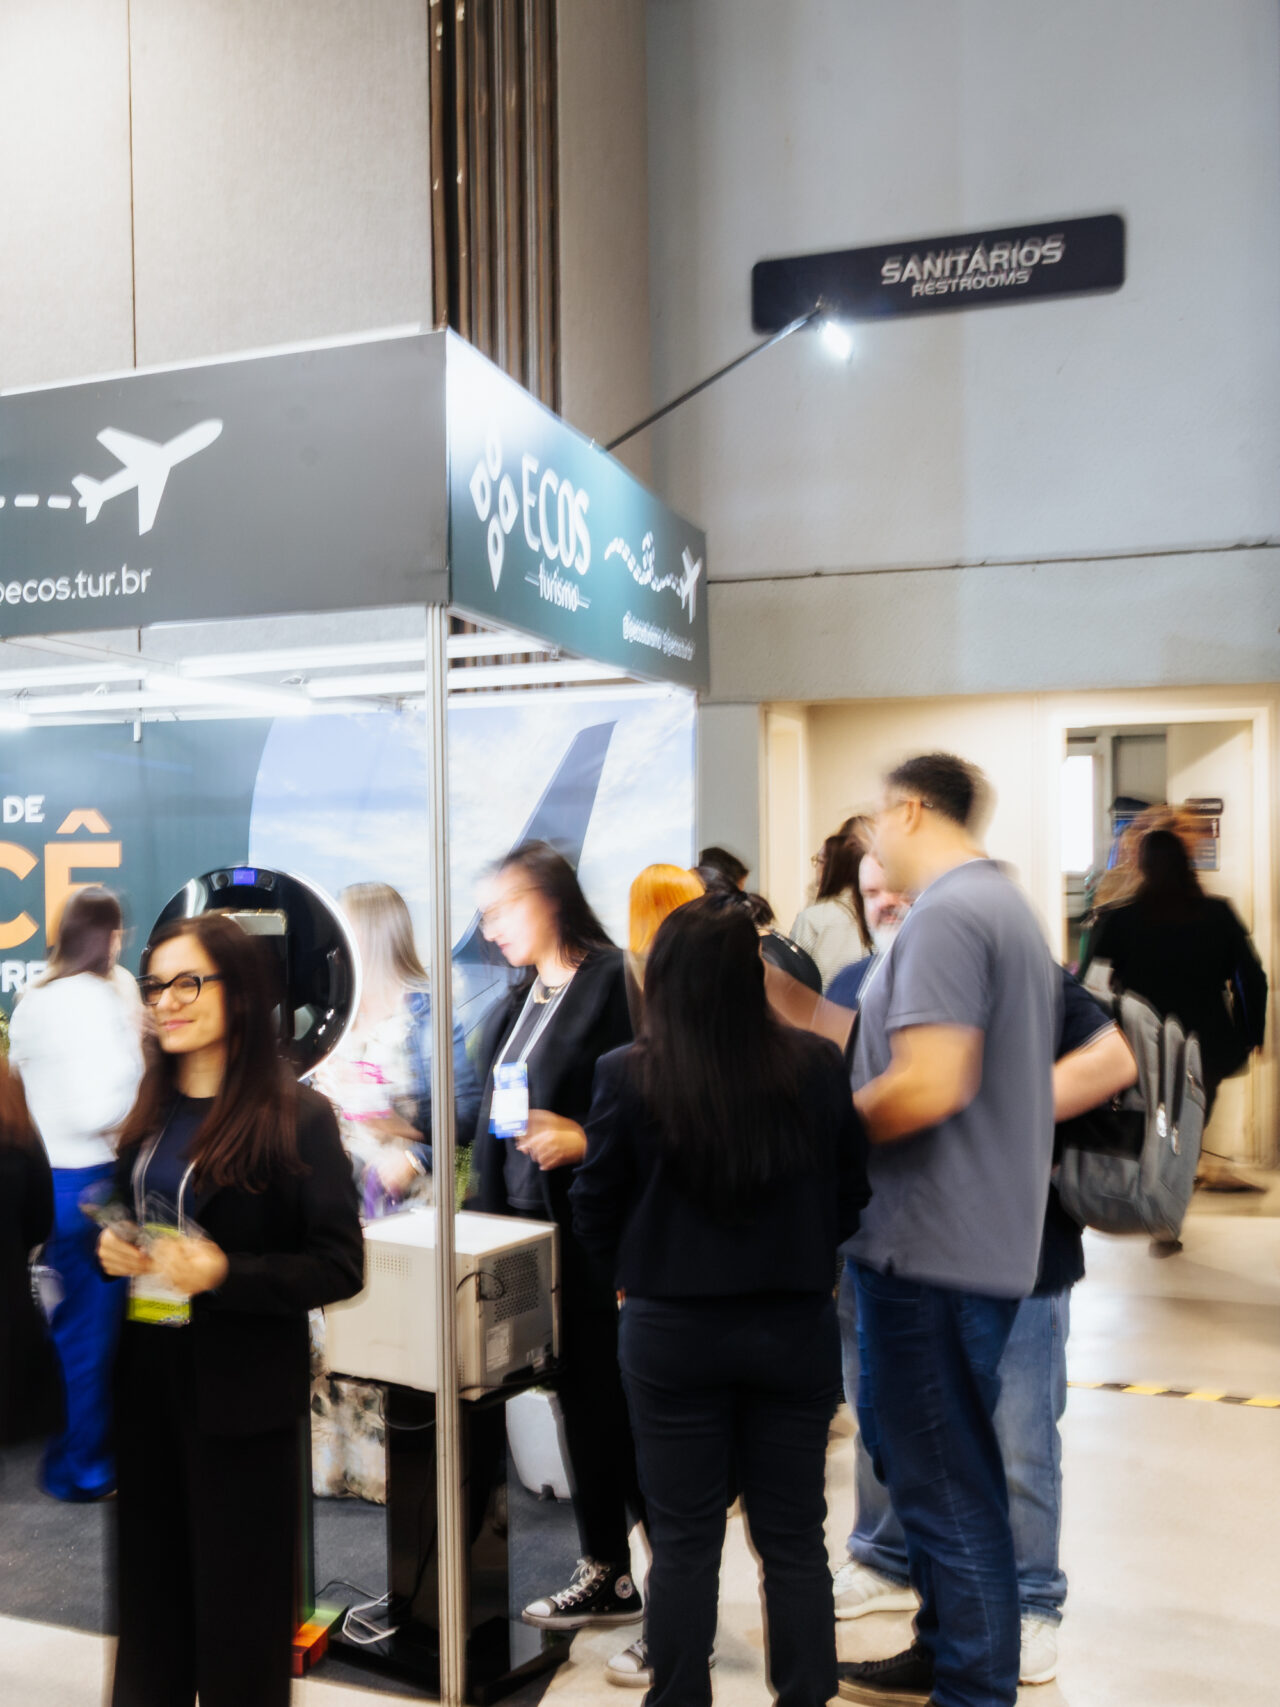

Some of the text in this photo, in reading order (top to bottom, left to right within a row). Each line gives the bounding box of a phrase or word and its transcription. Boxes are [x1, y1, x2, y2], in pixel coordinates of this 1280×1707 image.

[880, 236, 1065, 285] SANITÁRIOS
[911, 268, 1032, 298] RESTROOMS
[522, 451, 591, 576] ECOS
[539, 558, 580, 612] turismo
[3, 794, 46, 824] DE
